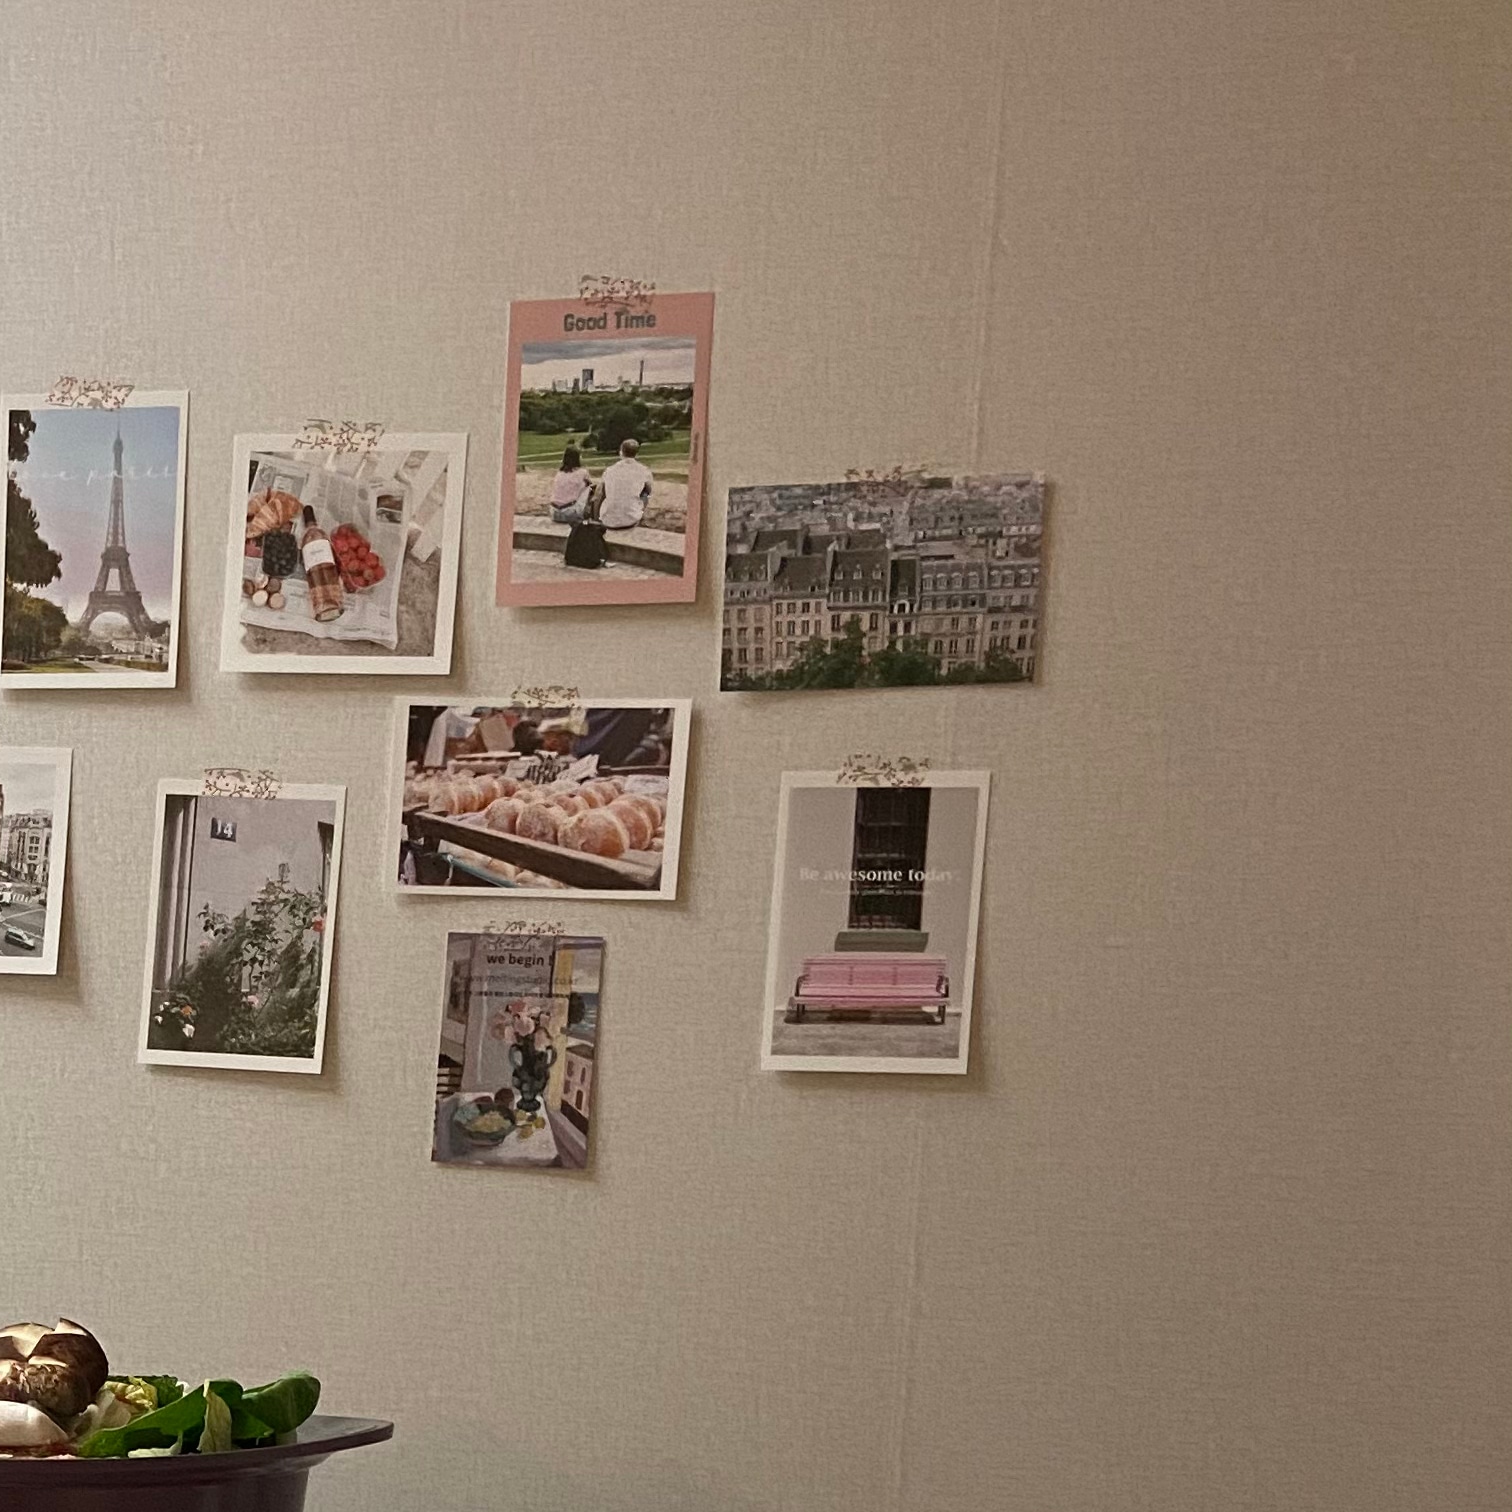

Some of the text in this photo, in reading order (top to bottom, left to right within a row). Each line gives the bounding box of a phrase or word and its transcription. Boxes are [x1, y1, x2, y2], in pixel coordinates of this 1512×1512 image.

[563, 311, 657, 332] Good Time
[798, 867, 820, 881] Be
[823, 868, 903, 882] awesome
[486, 954, 506, 965] we
[508, 953, 545, 969] begin
